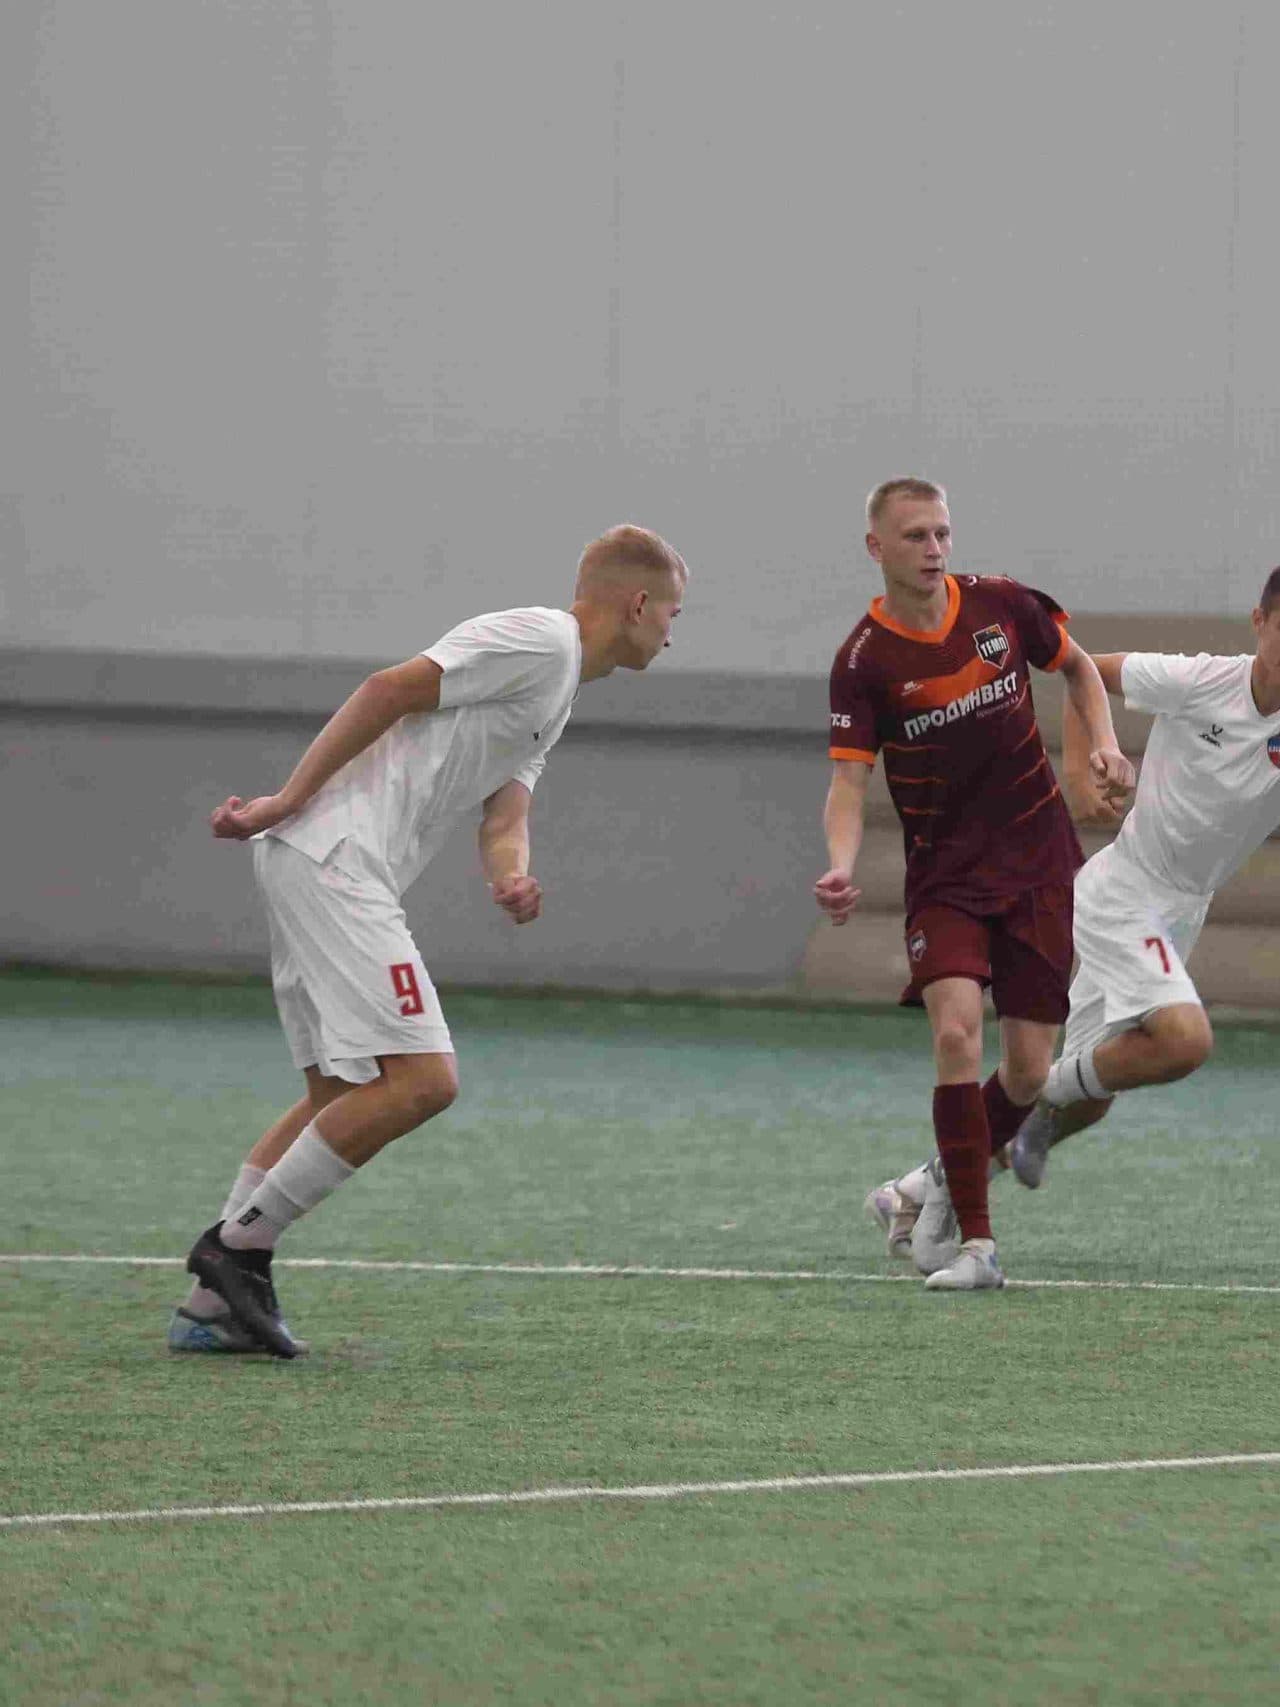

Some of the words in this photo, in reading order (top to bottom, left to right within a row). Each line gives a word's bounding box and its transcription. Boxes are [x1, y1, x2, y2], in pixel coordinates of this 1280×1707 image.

[980, 636, 1007, 657] ТЕМП
[904, 671, 1018, 741] ПРОДИНВЕСТ
[1145, 937, 1171, 974] 7
[389, 963, 424, 1016] 9
